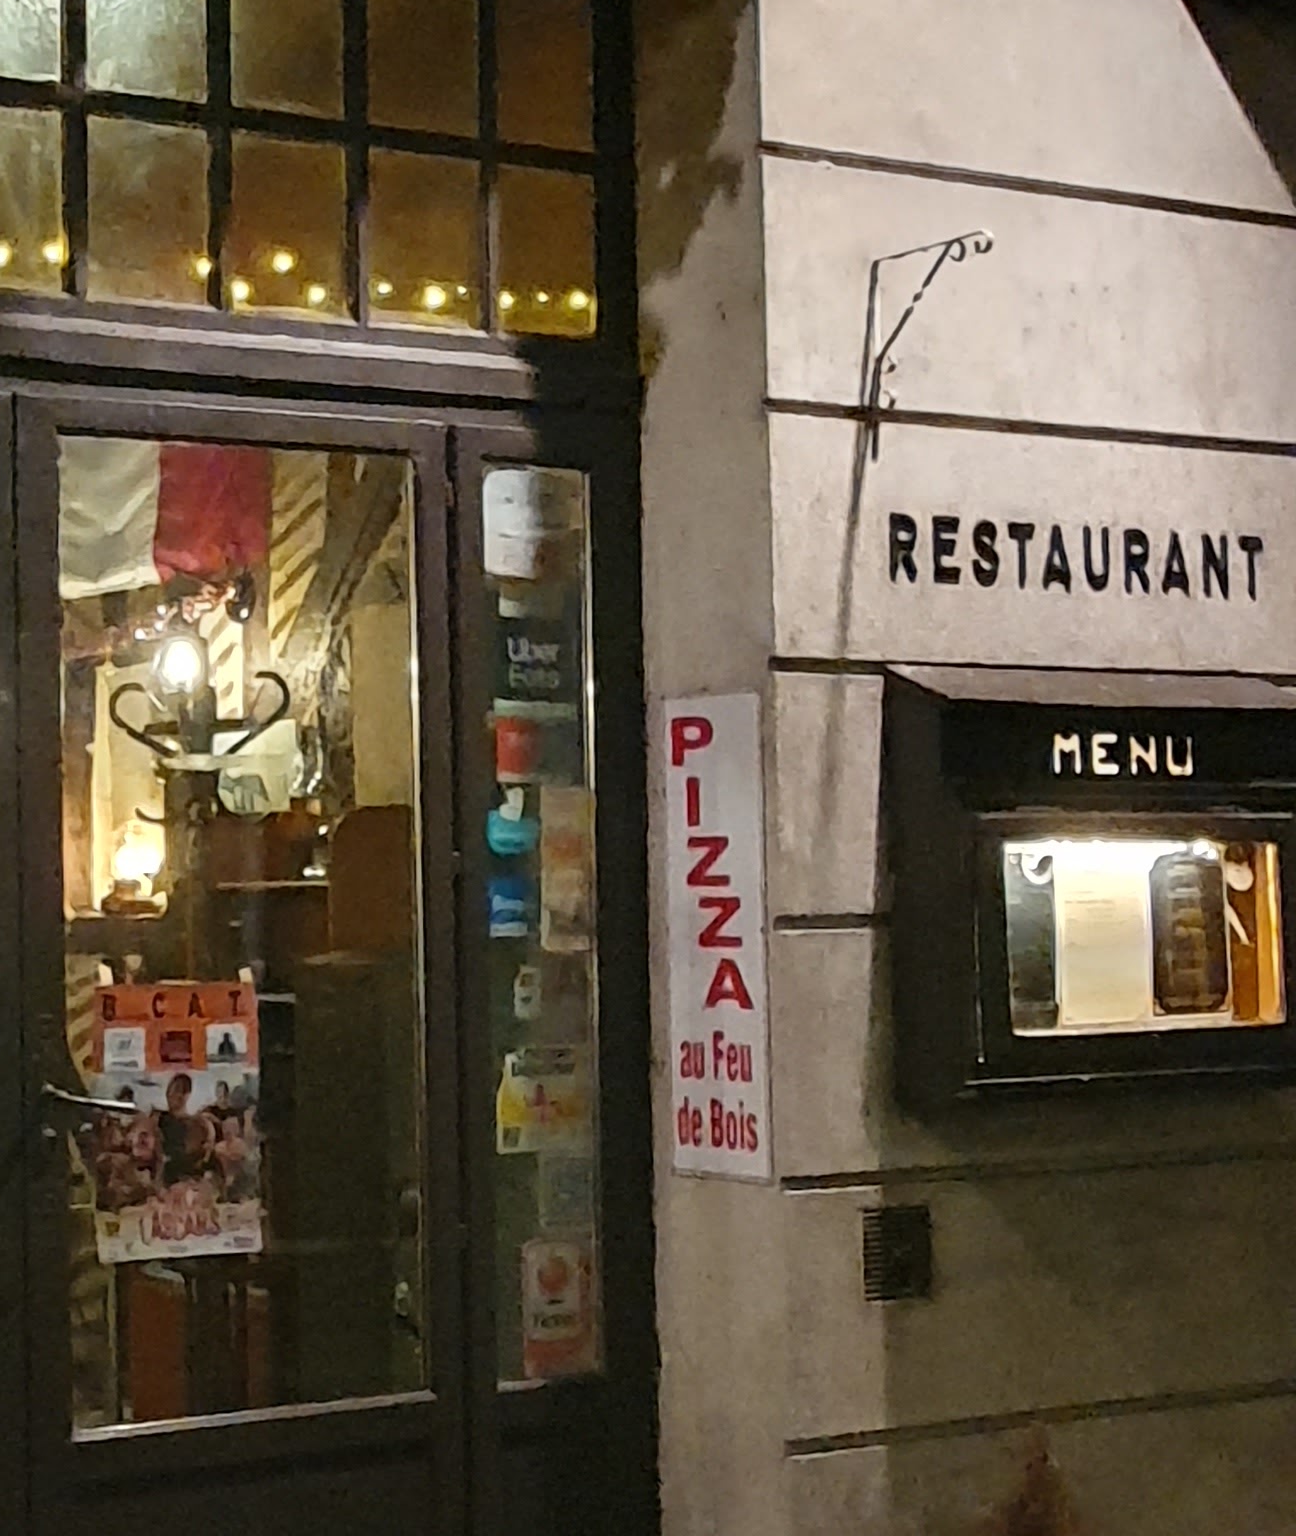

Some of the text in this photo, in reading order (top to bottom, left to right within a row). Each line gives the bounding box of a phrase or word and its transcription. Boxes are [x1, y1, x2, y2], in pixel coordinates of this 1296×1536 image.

[888, 512, 1263, 602] RESTAURANT
[1053, 733, 1194, 777] MENU
[670, 716, 754, 1010] PIZZA
[680, 1030, 752, 1082] au Feu
[677, 1095, 758, 1153] de Bois
